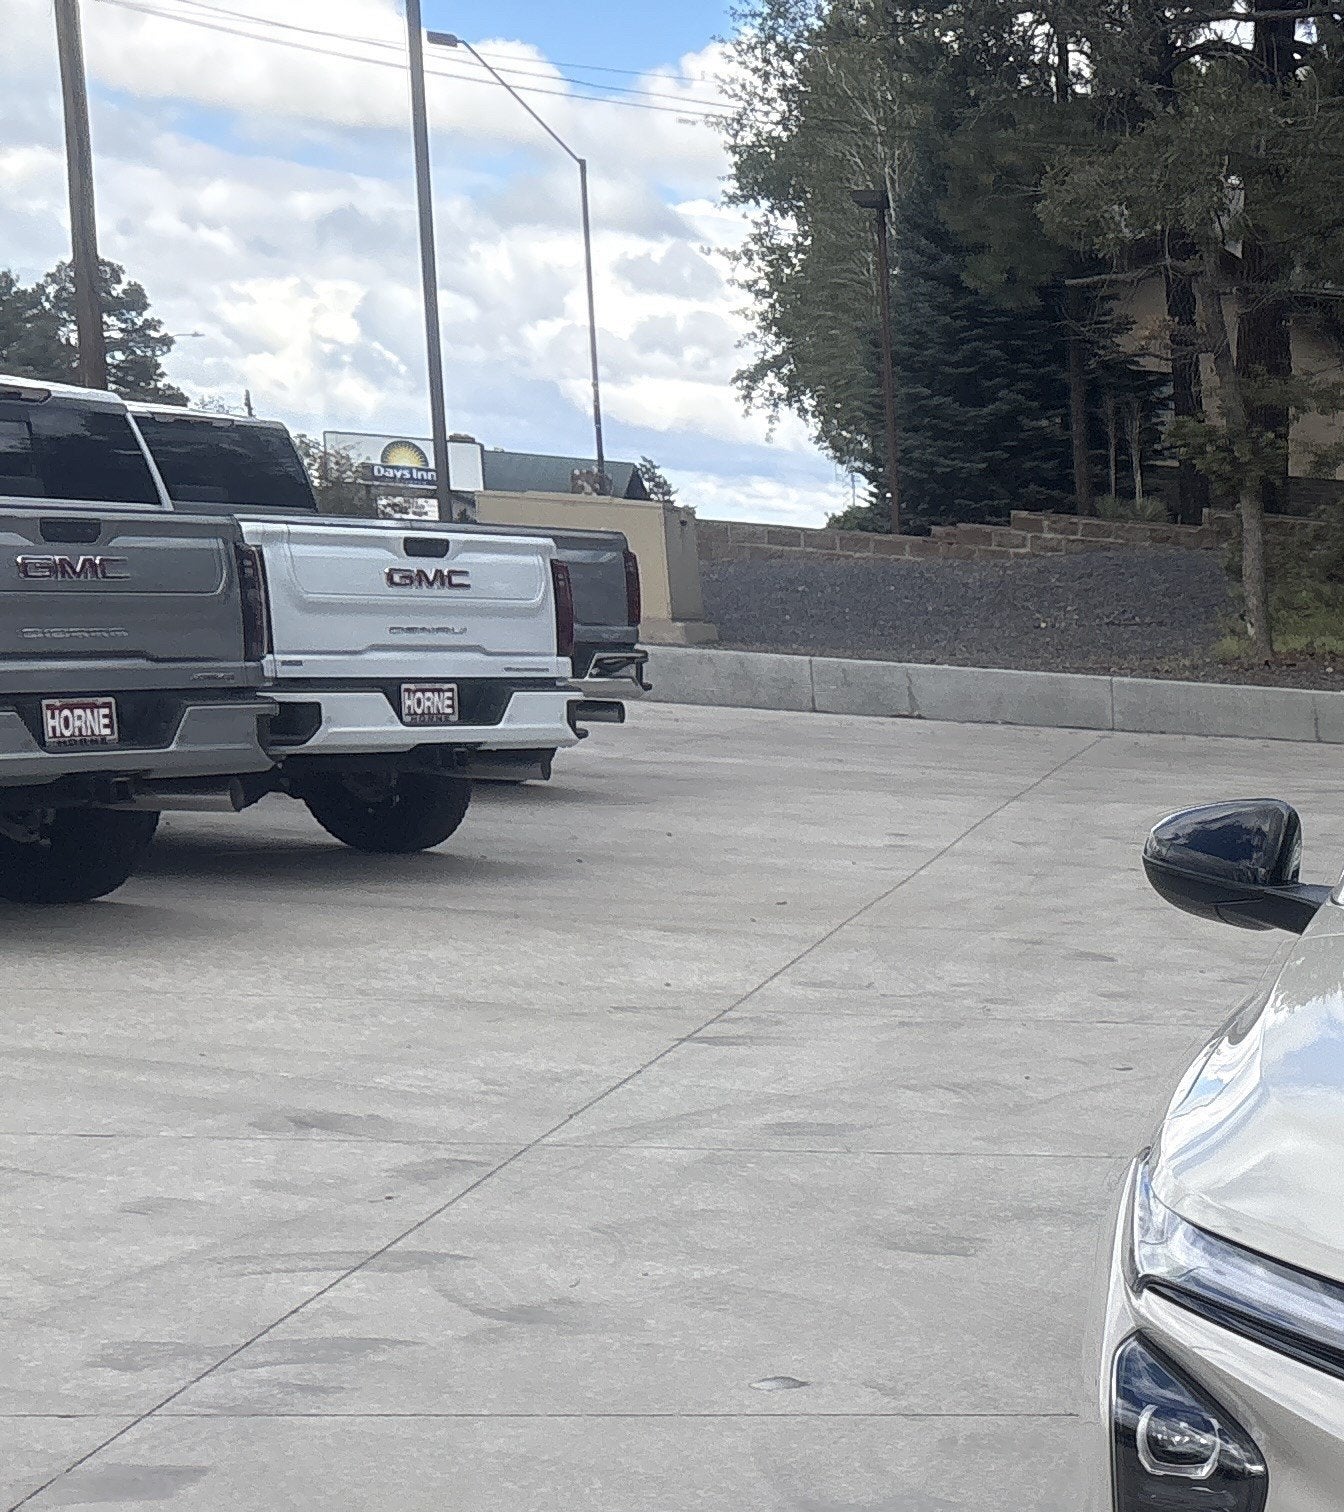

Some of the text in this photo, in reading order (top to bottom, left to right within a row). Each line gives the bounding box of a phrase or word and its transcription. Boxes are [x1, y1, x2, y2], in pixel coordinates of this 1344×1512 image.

[373, 465, 437, 481] Days Inn
[17, 555, 131, 580] GMC
[384, 567, 471, 590] GMC
[404, 691, 453, 714] HORNE
[46, 708, 112, 737] HORNE
